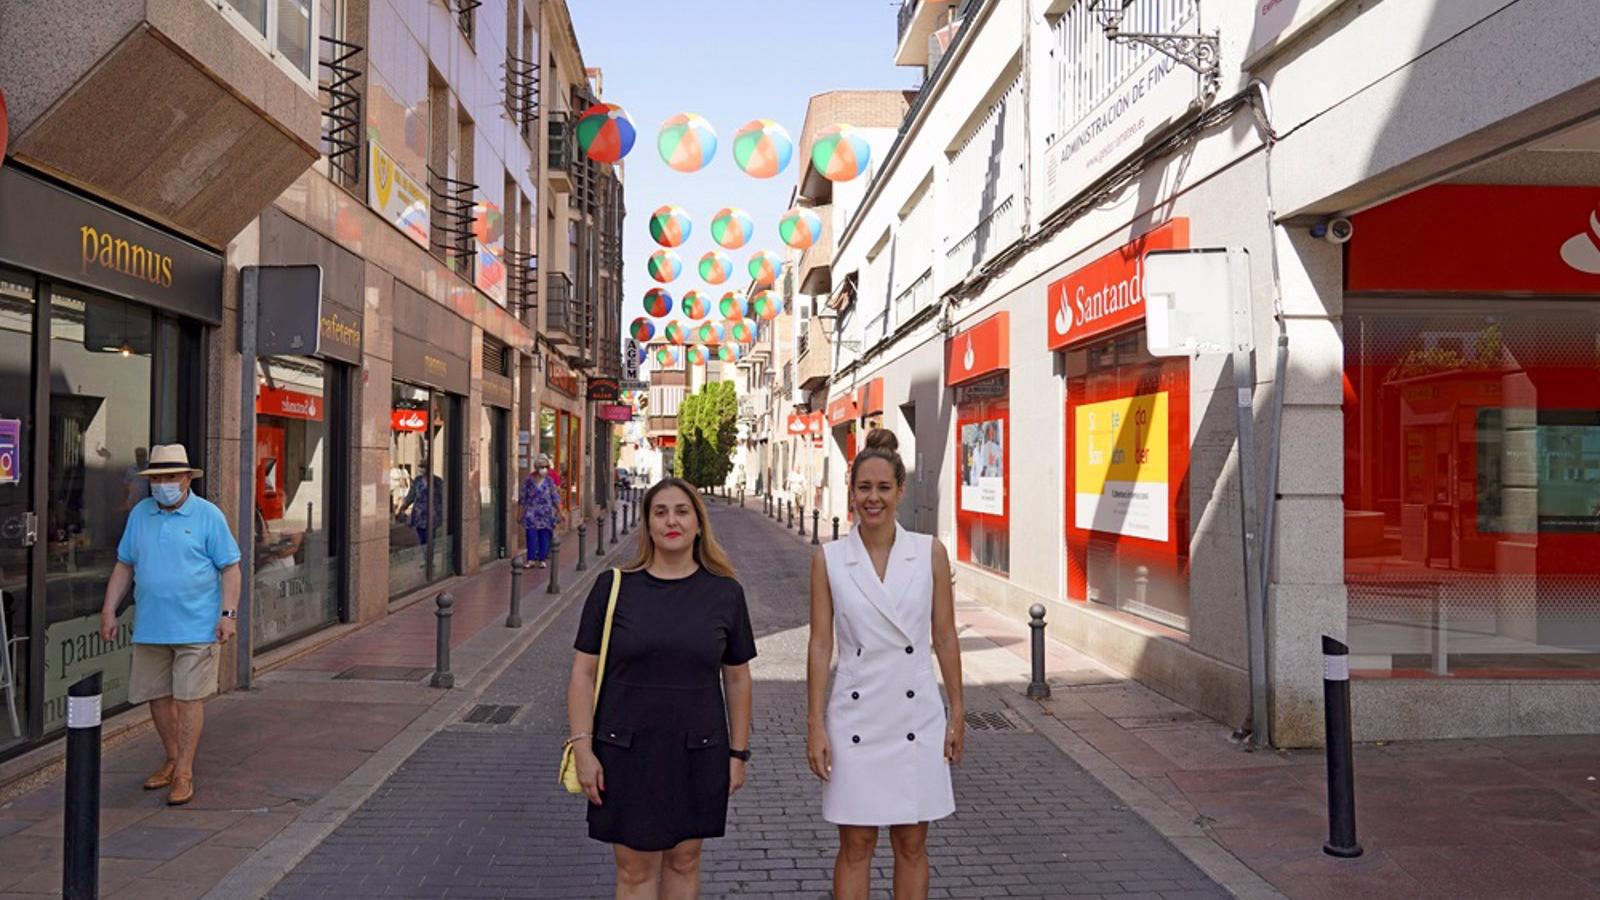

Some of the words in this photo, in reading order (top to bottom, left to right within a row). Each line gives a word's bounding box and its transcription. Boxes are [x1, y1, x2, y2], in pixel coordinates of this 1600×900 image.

[1132, 77, 1145, 105] DE
[80, 225, 174, 289] pannus
[627, 340, 637, 379] AGEM
